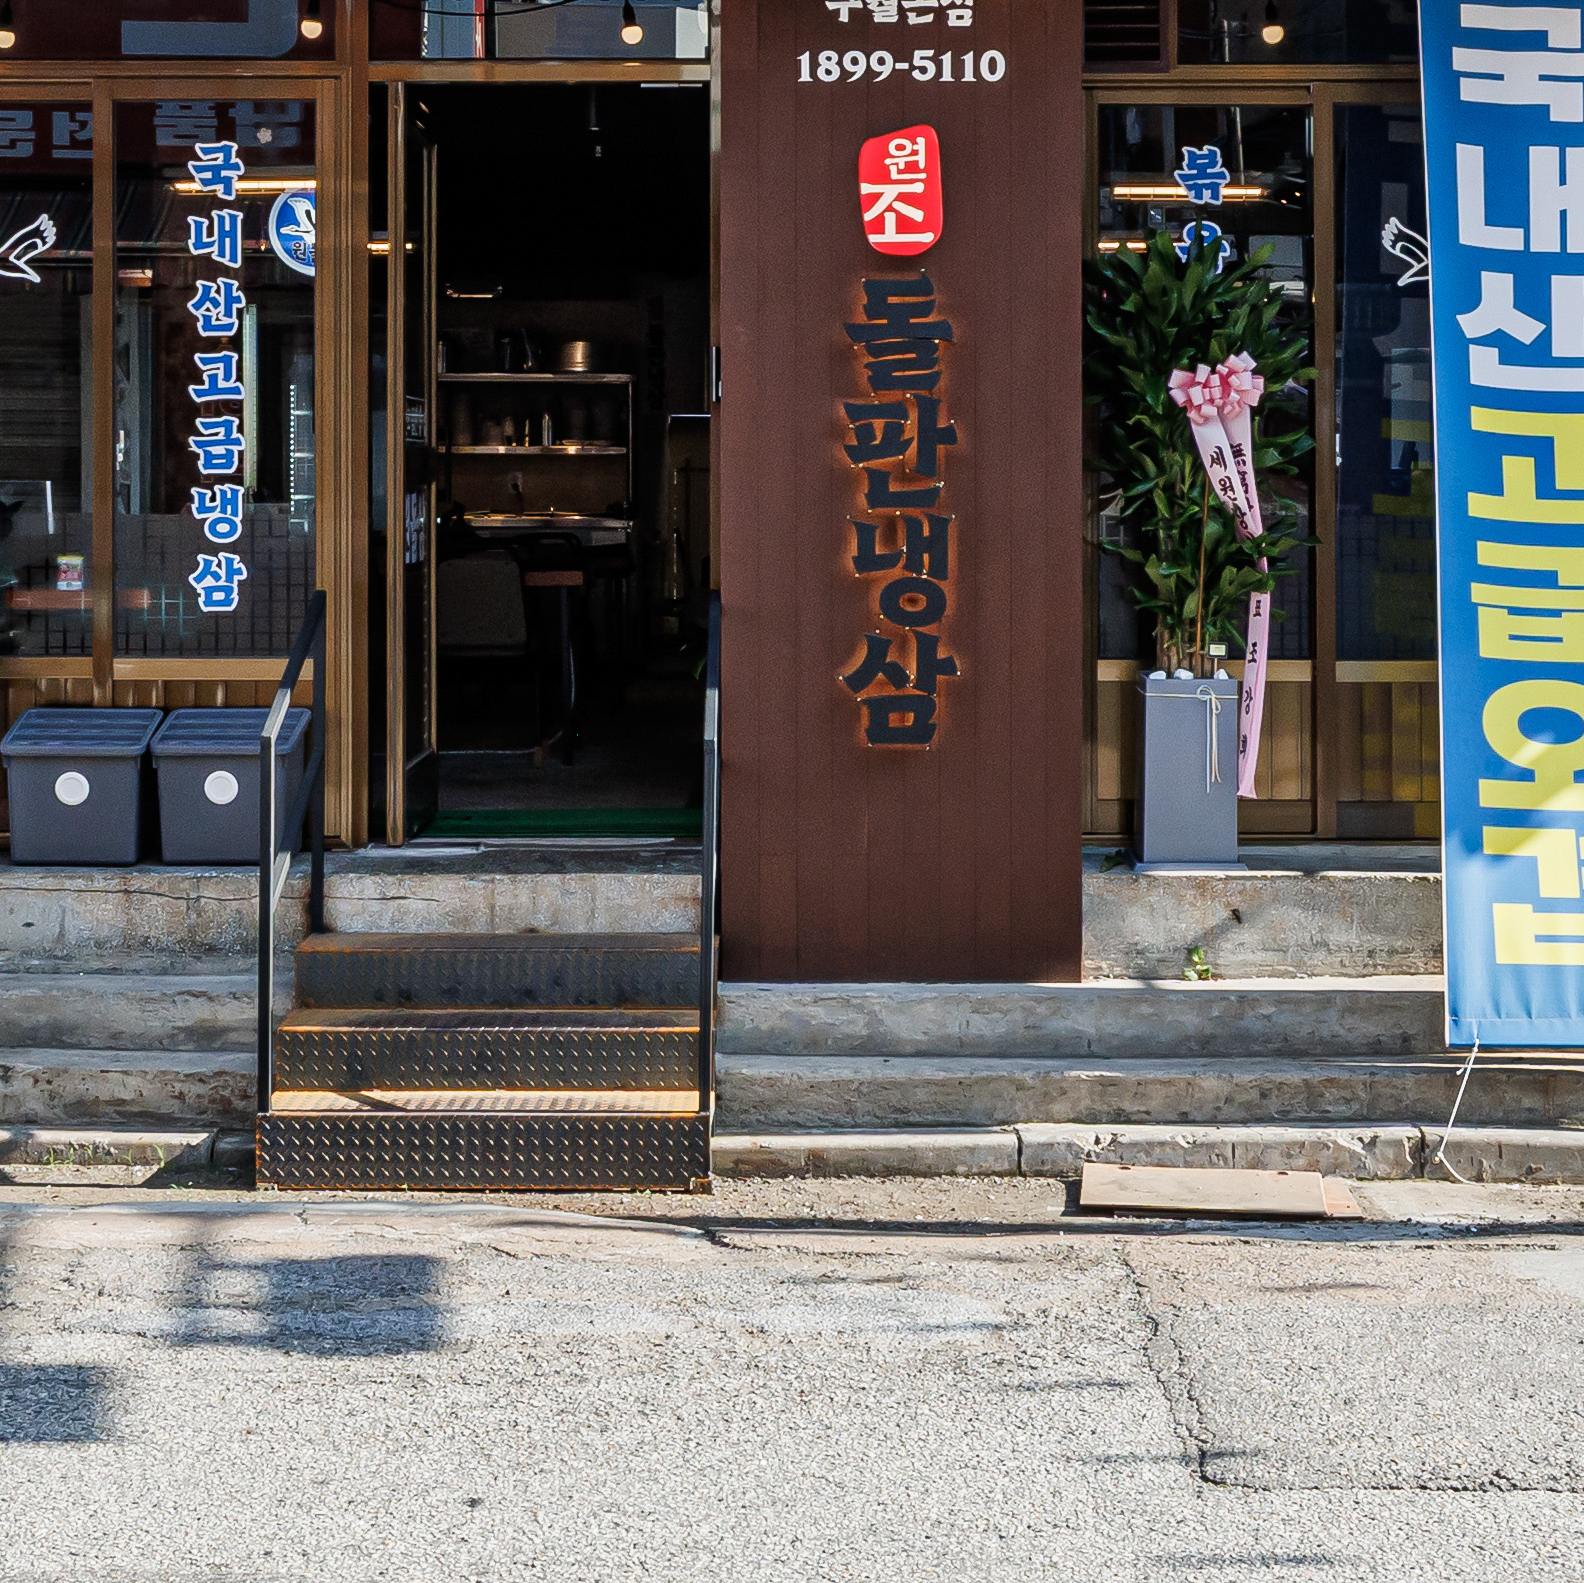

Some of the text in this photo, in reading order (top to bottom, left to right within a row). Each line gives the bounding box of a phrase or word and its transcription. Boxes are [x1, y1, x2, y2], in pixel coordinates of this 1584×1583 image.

[796, 49, 1007, 83] 1899-5110
[860, 136, 935, 244] 원조
[188, 141, 247, 613] 국내산고급냉삼
[838, 272, 961, 749] 돌판냉삼
